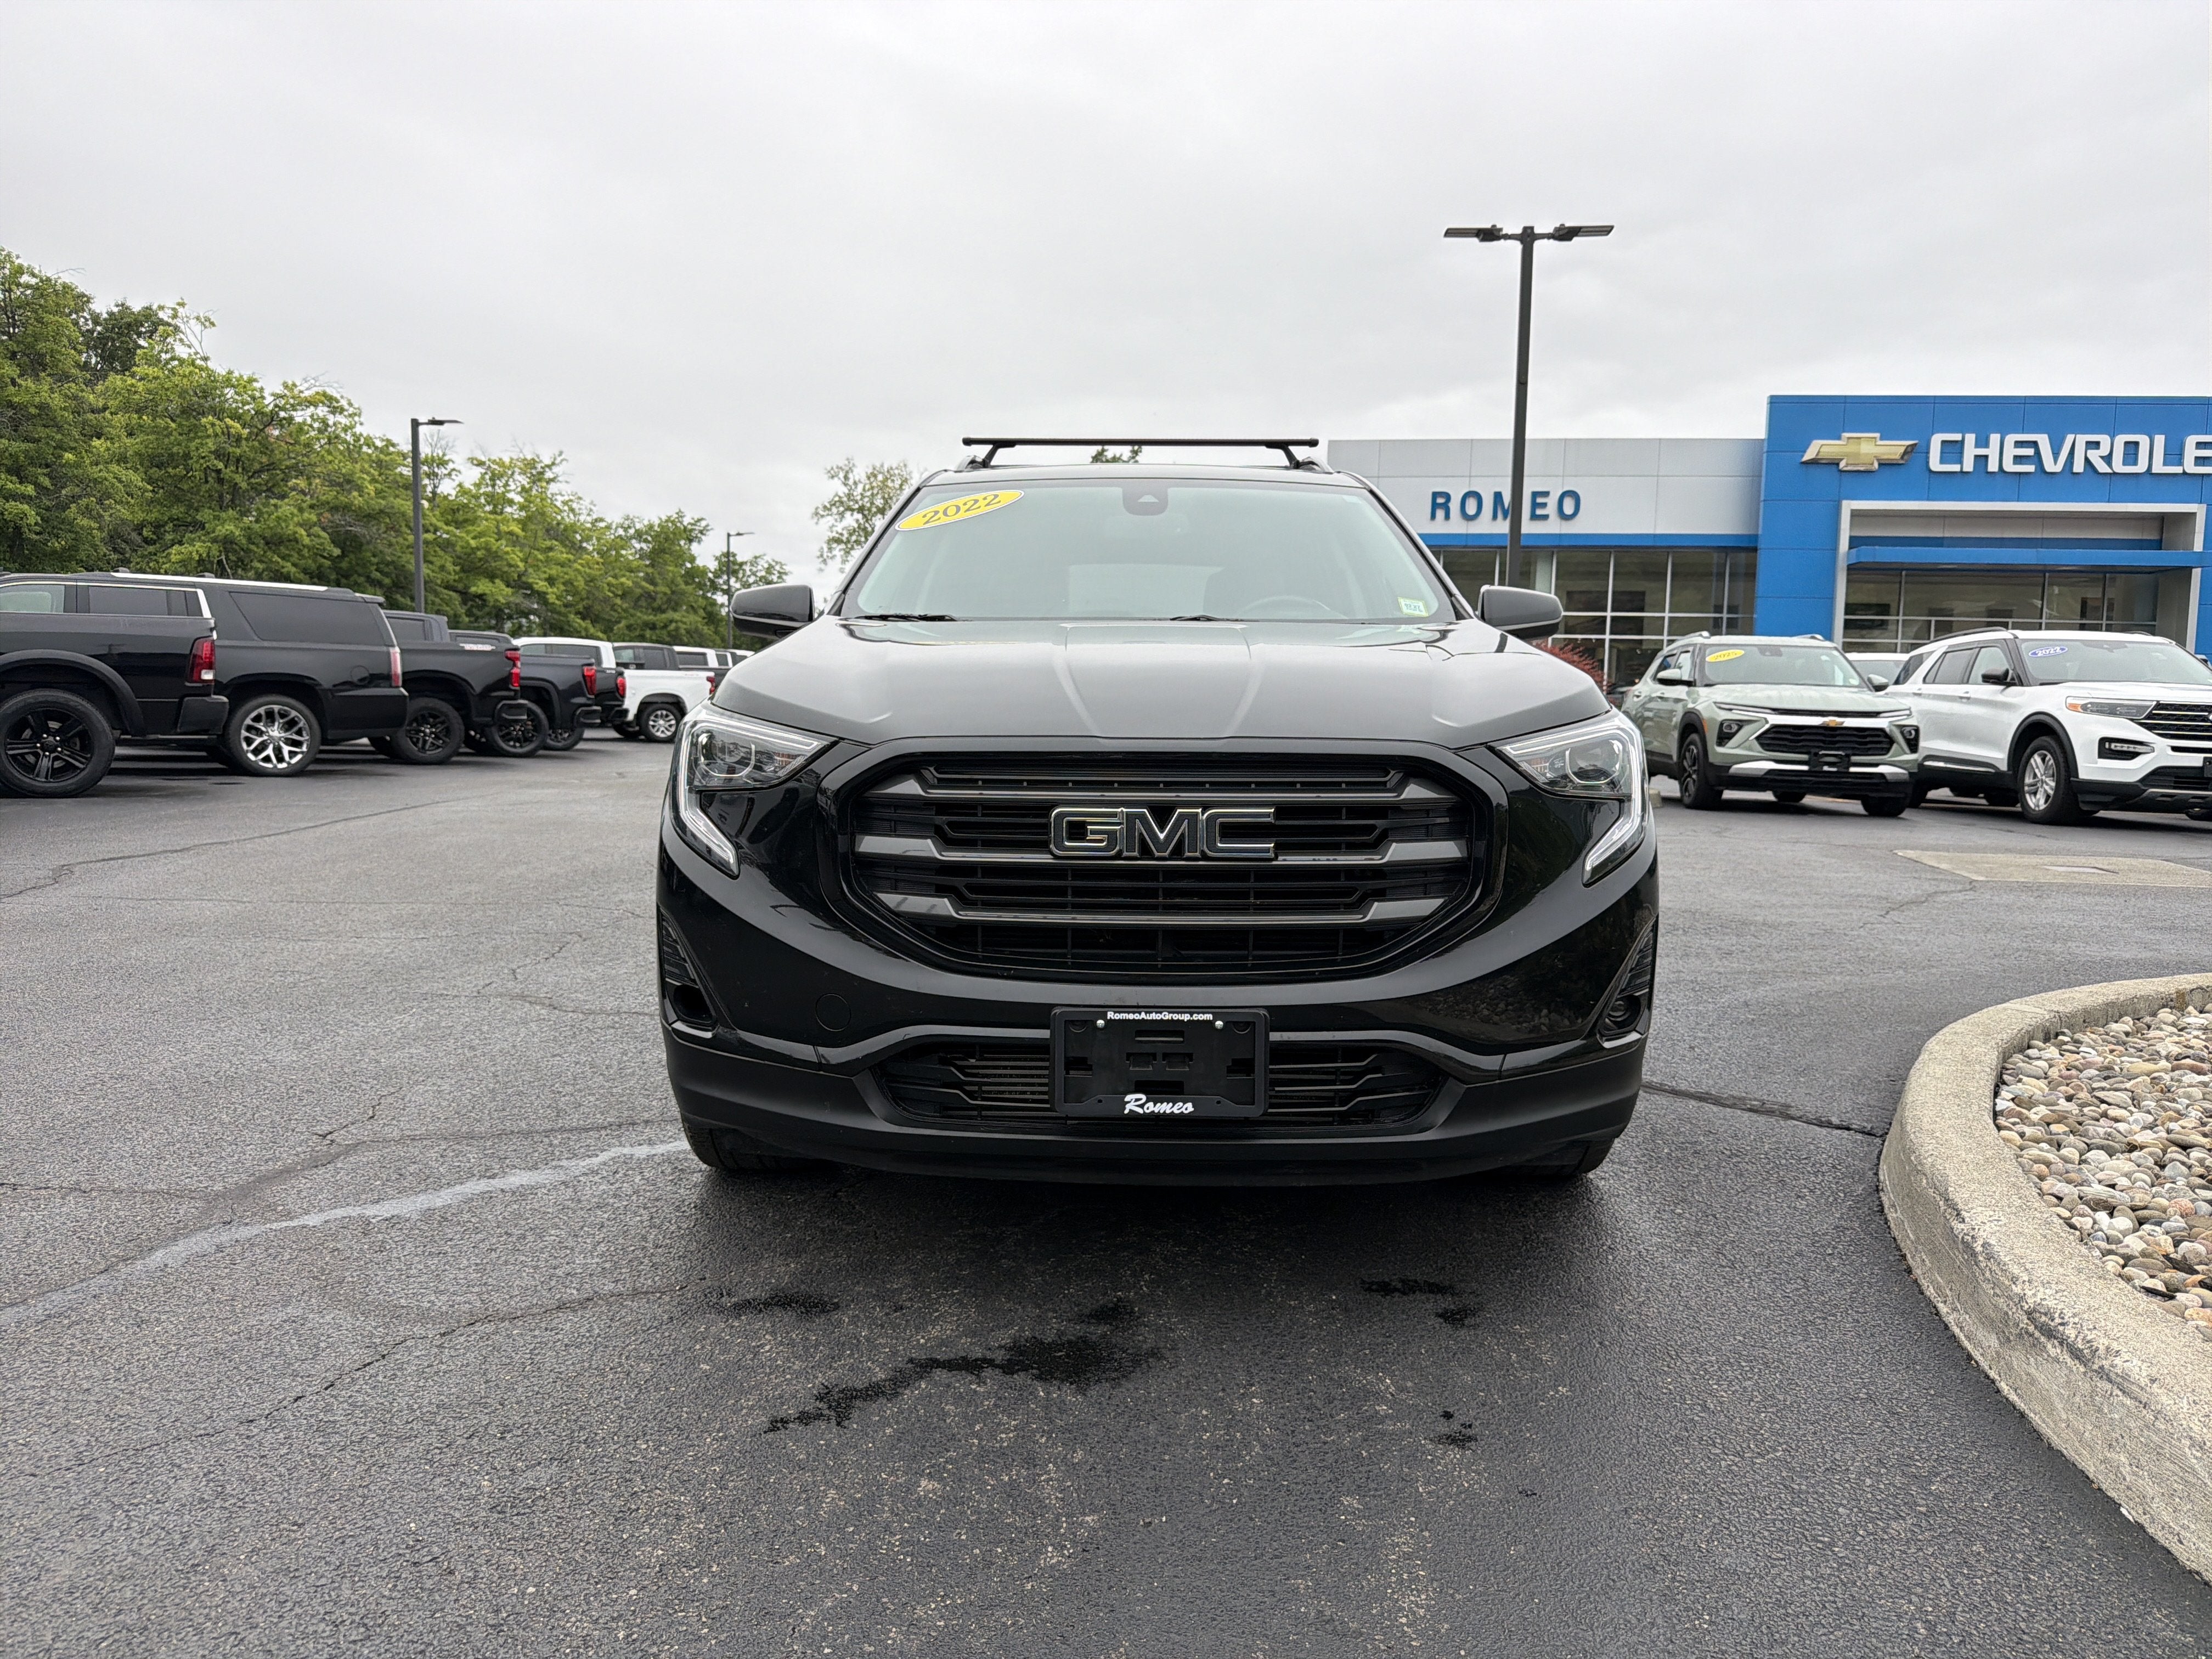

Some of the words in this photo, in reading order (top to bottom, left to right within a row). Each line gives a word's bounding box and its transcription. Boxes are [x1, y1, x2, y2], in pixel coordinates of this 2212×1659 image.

[922, 494, 1001, 525] 2022
[1430, 490, 1581, 521] ROMEO
[2036, 646, 2062, 657] 2022
[1050, 808, 1276, 859] GMC
[1107, 1012, 1213, 1022] RomeoAutoGroup.com
[1124, 1093, 1194, 1114] Romeo
